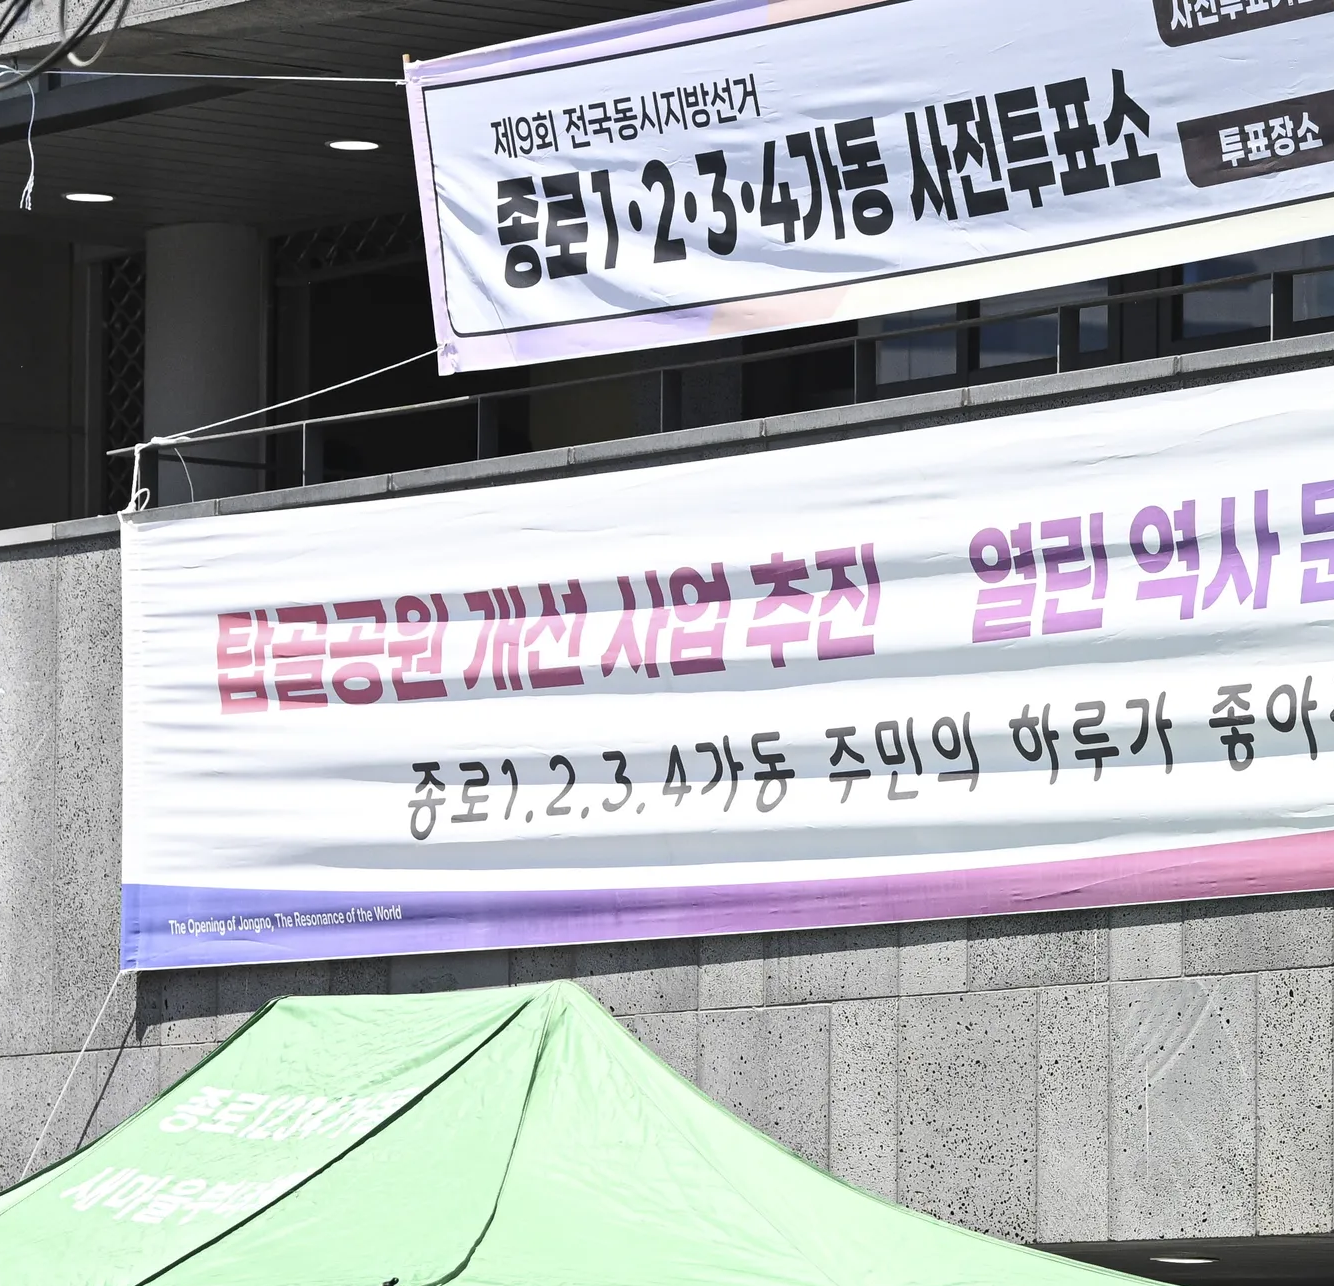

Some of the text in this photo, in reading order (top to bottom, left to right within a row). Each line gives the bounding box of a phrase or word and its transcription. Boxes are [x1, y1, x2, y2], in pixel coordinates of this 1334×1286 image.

[490, 74, 761, 159] 제9회 전국동시지방선거
[1218, 112, 1323, 166] 투표장소
[498, 67, 1161, 290] 종로1·2·3·4가동 사전투표소
[216, 592, 449, 716] 탑골공원
[462, 576, 585, 692] 개선
[599, 562, 732, 678] 사업
[747, 543, 881, 668] 추진
[967, 510, 1108, 644] 열린
[1128, 488, 1279, 622] 역사
[407, 731, 797, 842] 종로1.2.3.4가동
[826, 711, 981, 805] 주민의
[1007, 693, 1174, 785] 하루가
[169, 904, 402, 937] The Opening of Jongno, The Resonance of the World
